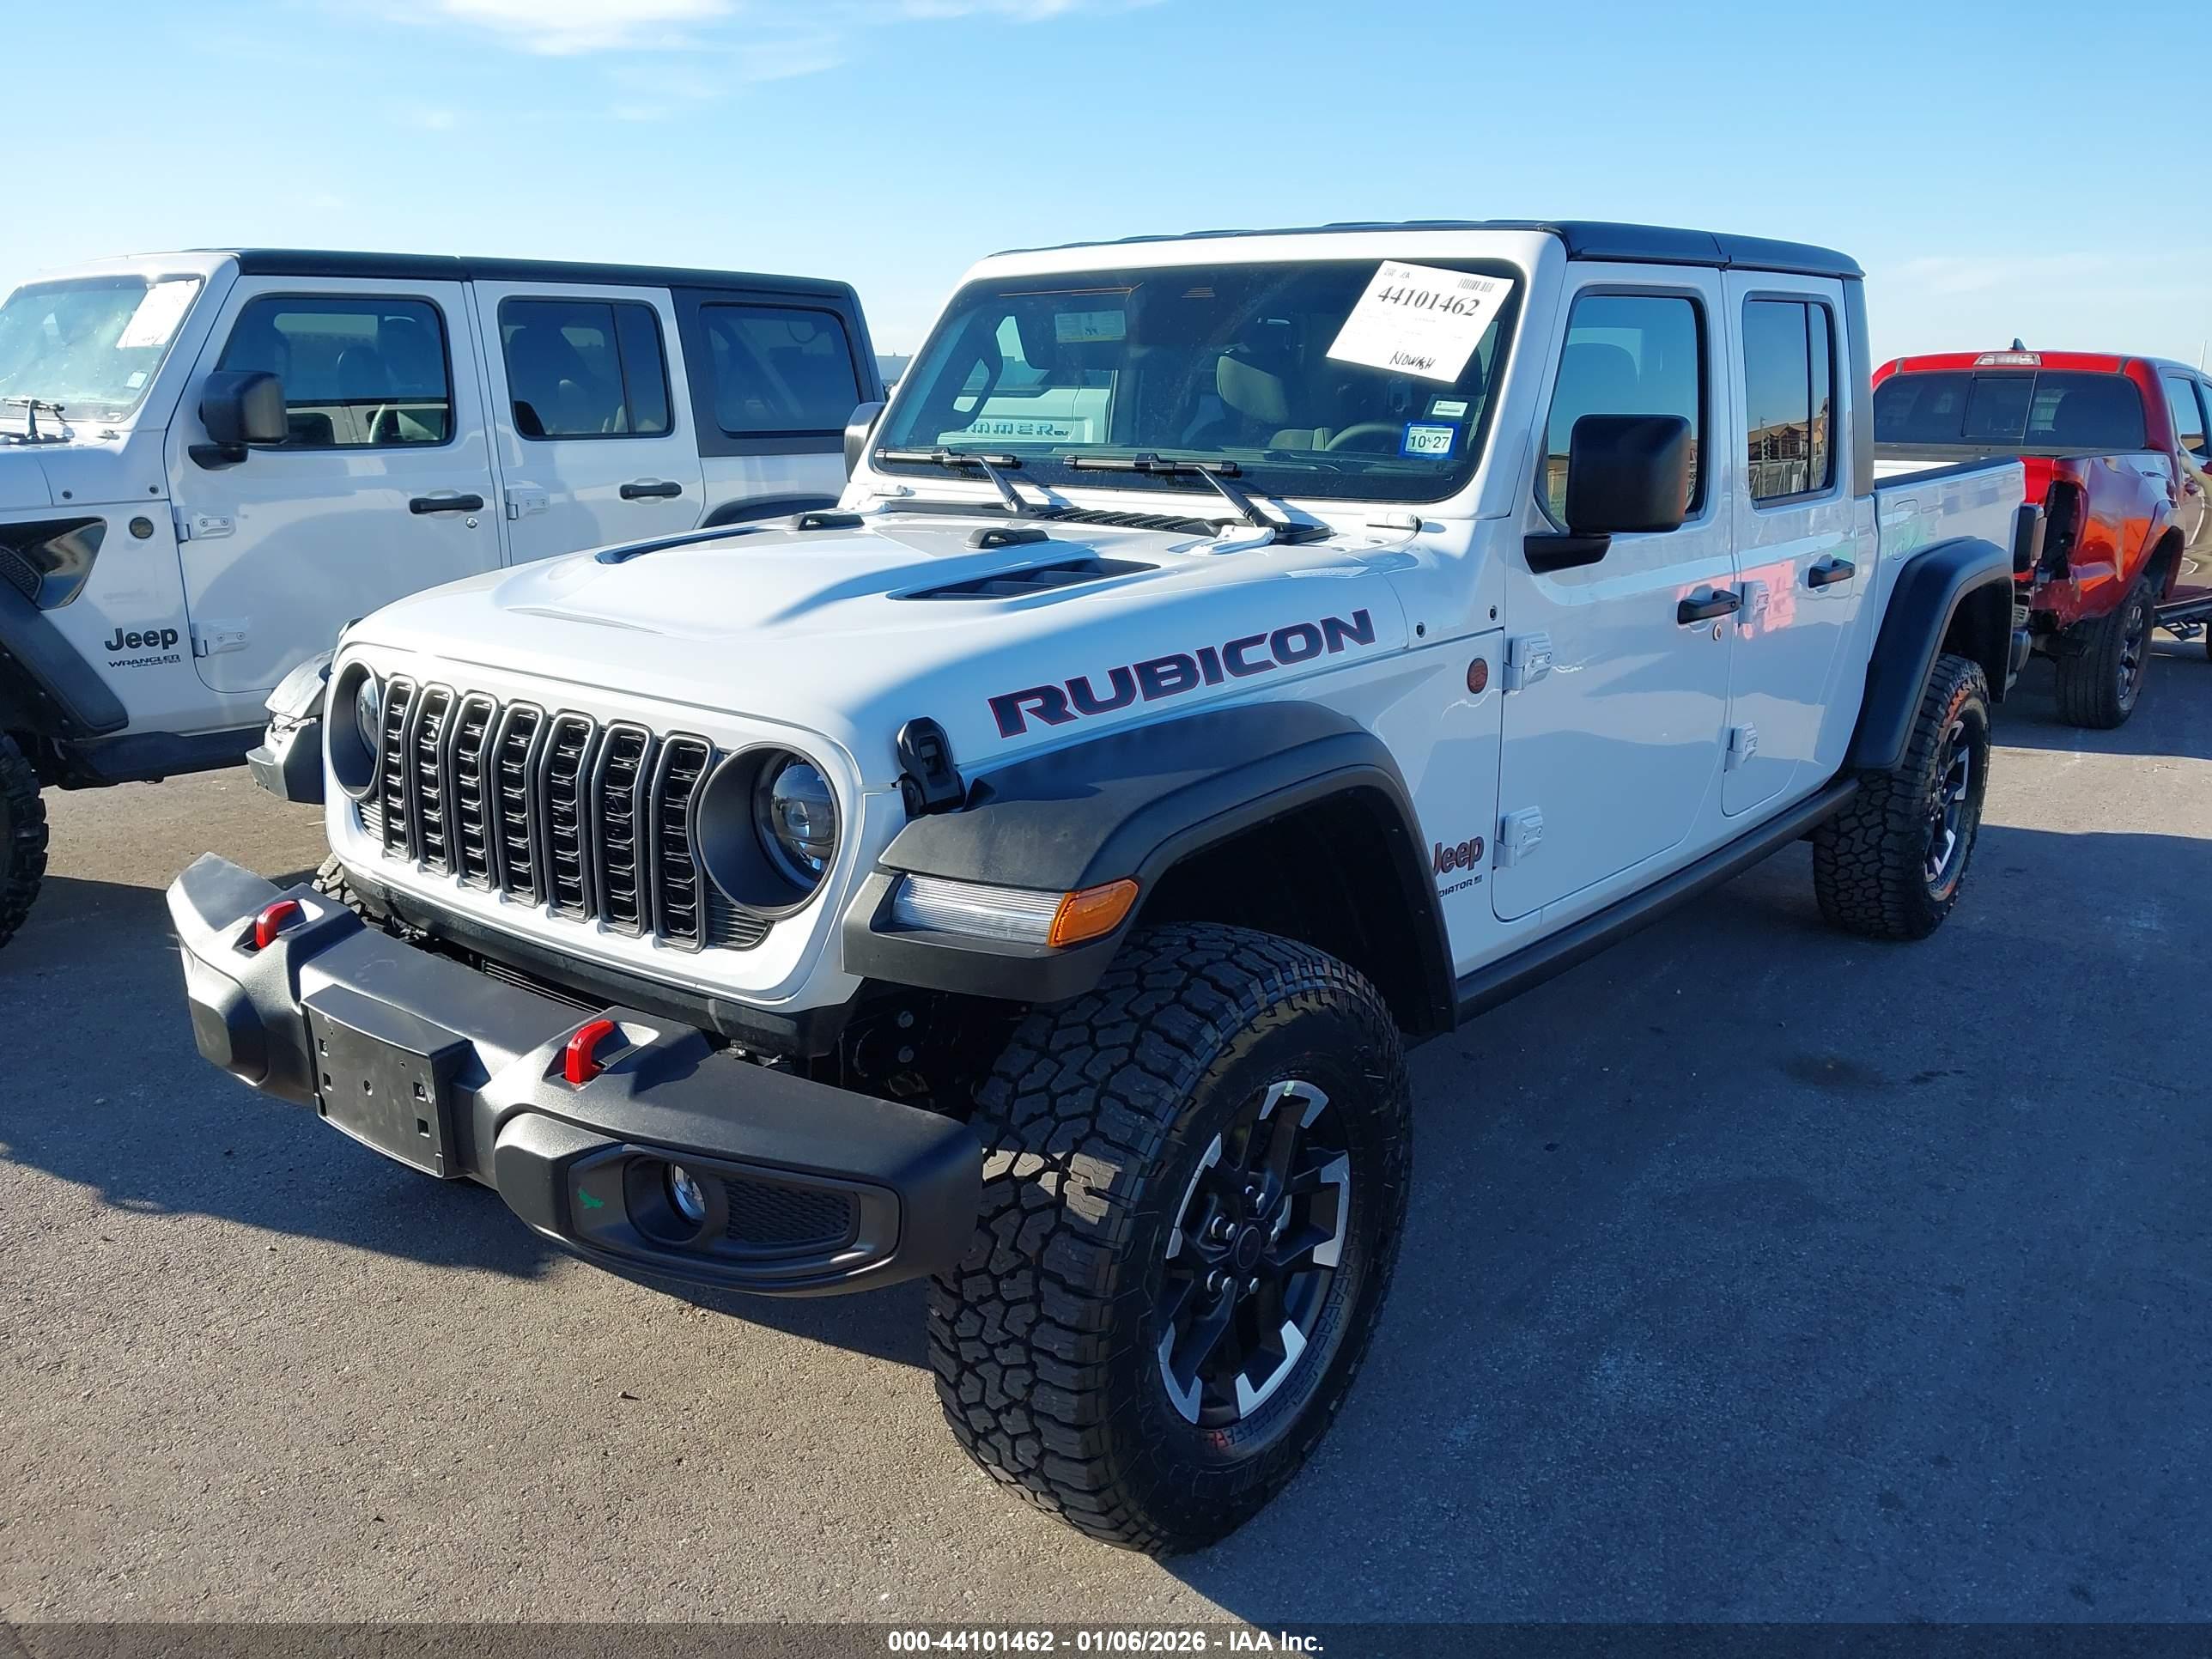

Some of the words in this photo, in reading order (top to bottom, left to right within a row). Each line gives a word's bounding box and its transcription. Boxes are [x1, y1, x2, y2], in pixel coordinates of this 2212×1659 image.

[1377, 285, 1480, 317] 44101462
[963, 422, 1054, 436] MMER
[1410, 435, 1426, 448] 10
[1432, 436, 1450, 448] 27
[104, 627, 179, 651] Jeep
[108, 654, 180, 667] WRANGLER
[988, 608, 1376, 738] RUBICON
[1433, 836, 1485, 878] Jeep
